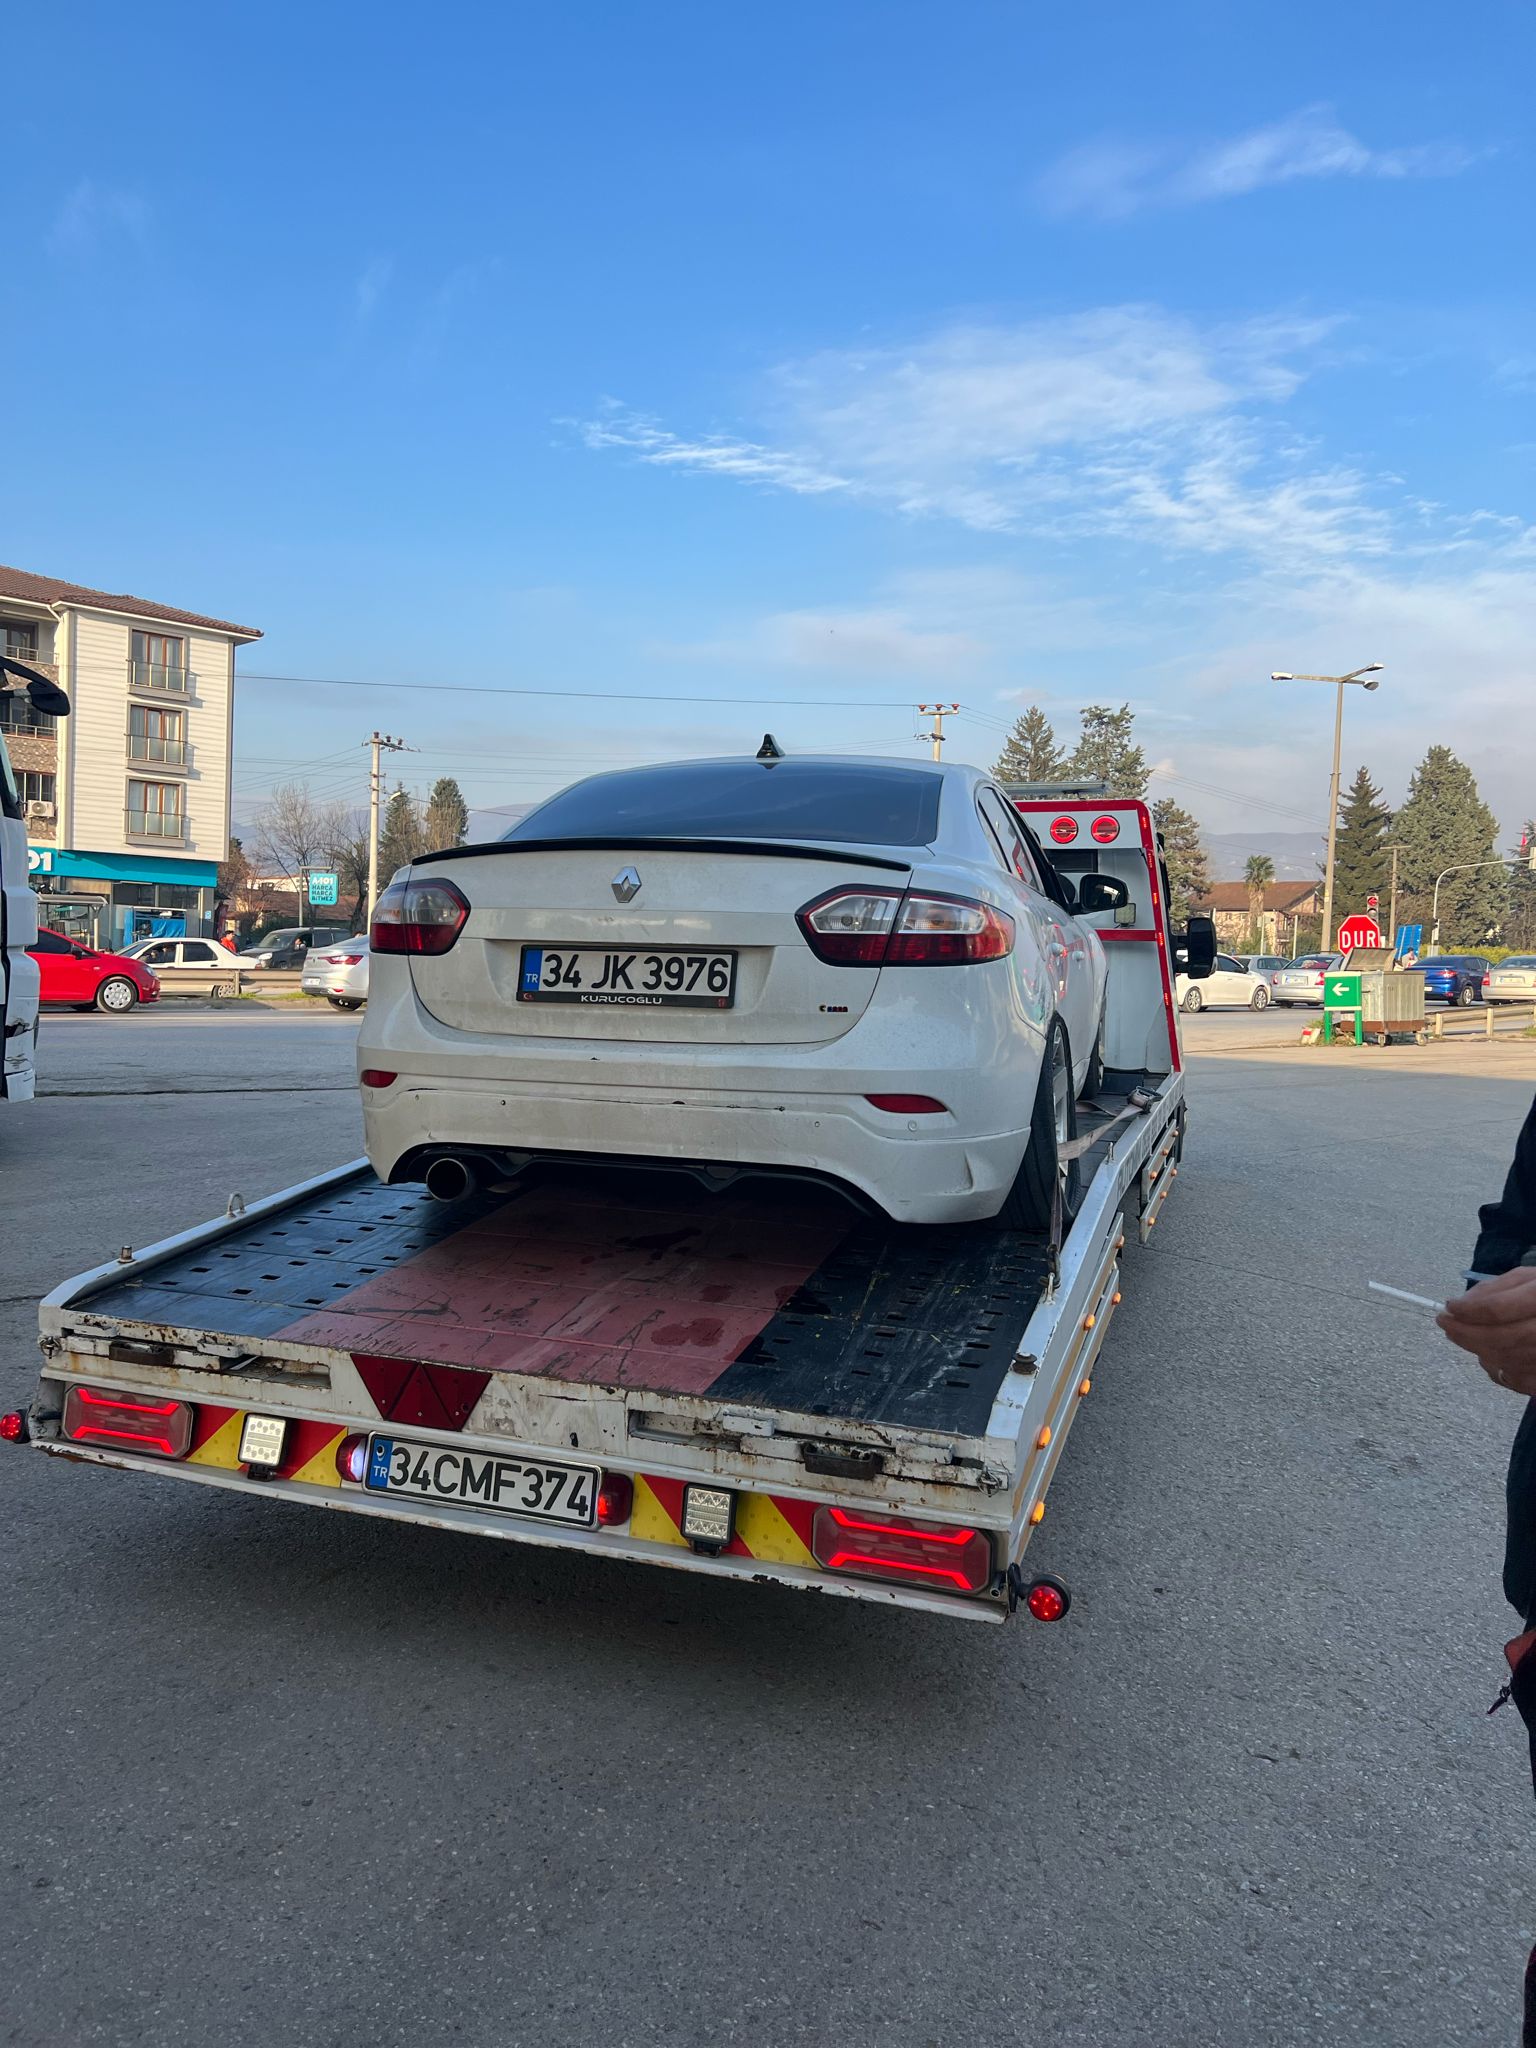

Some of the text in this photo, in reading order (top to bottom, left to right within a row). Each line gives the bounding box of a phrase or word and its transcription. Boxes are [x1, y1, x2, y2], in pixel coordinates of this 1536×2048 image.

[1341, 930, 1376, 948] DUR
[525, 953, 730, 993] TR 34 JK 3976
[373, 1465, 388, 1479] TR
